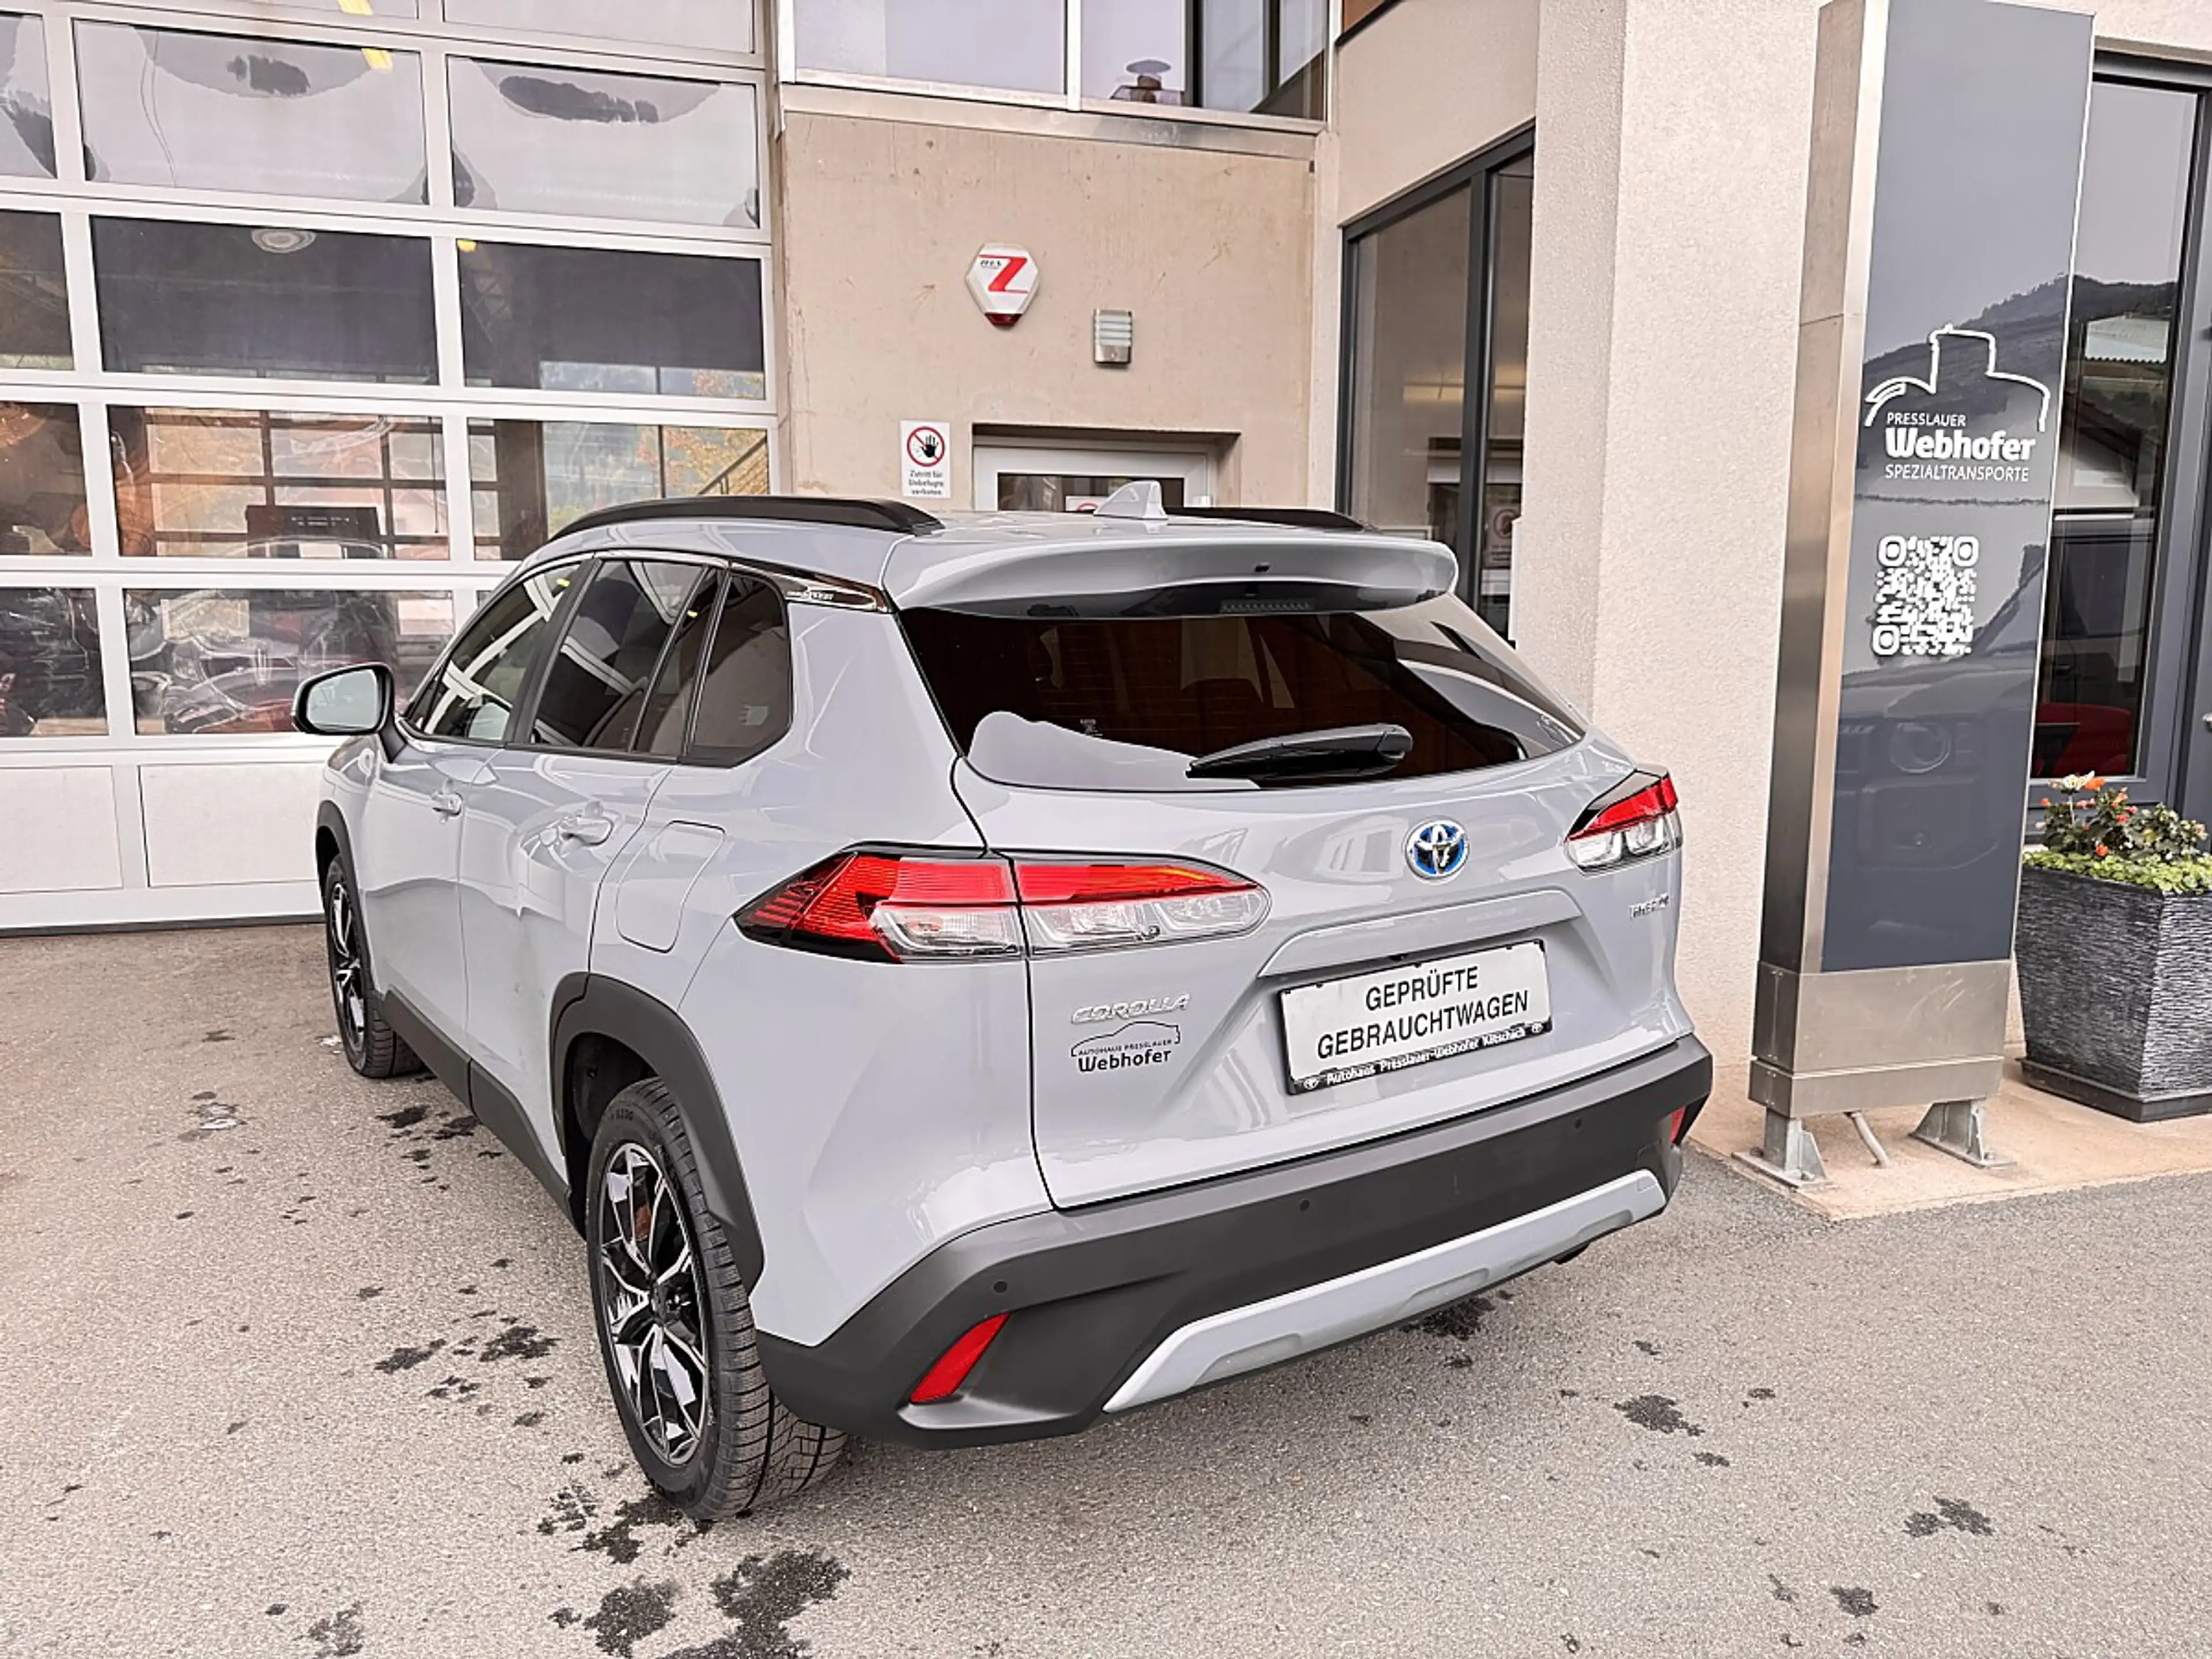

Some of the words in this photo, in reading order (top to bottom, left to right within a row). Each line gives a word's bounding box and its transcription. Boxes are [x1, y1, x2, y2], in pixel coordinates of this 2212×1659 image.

[1887, 412, 1967, 427] PRESSLAUER
[1884, 427, 2036, 460] Webhofer
[1885, 464, 2030, 482] SPEZIALTRANSPORTE
[1365, 966, 1479, 1011] GEPRÜFTE
[1071, 993, 1191, 1025] COROLLA
[1317, 990, 1529, 1059] GEBRAUCHTWAGEN
[1078, 1045, 1122, 1055] AUTOHAUS
[1124, 1039, 1172, 1051] PRESSLAUER
[1078, 1049, 1172, 1072] Webhofer
[1327, 1065, 1376, 1085] Autohaus
